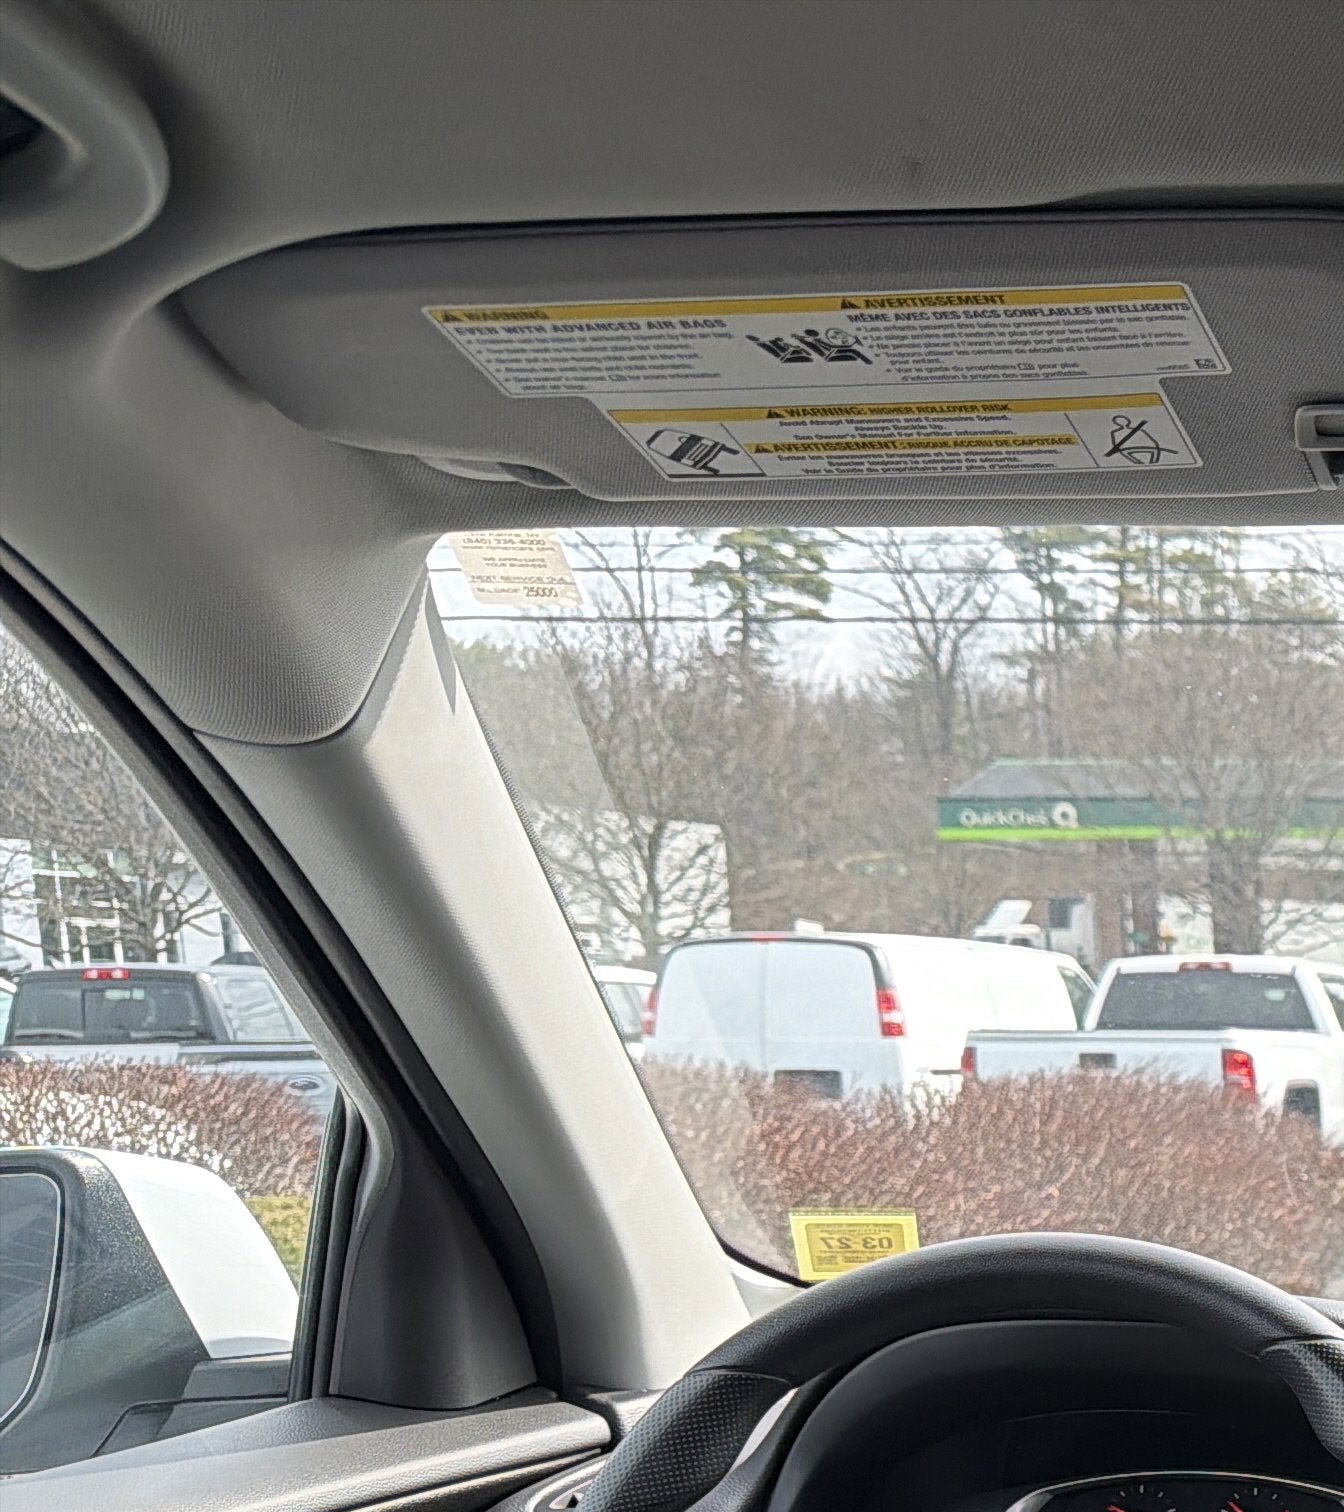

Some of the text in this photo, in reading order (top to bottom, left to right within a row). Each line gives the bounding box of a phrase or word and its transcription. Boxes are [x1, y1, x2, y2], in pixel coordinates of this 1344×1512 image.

[863, 294, 1006, 310] AVERTISSEMENT
[464, 310, 549, 322] WARNING
[894, 311, 930, 322] AVEC
[932, 311, 962, 320] DES
[962, 310, 1002, 319] SACS
[1003, 306, 1093, 319] GONFLABLES
[1094, 302, 1191, 315] INTELLIGENTS
[454, 318, 728, 338] EVEN WITH ADVANCED AIR BAGS
[869, 406, 915, 415] HIGHER
[915, 404, 978, 414] ROLLOVER
[981, 403, 1013, 412] RISK
[773, 440, 898, 452] AVERTISSEMENT
[994, 439, 1010, 447] DE
[1012, 436, 1076, 446] CAPOTAGE
